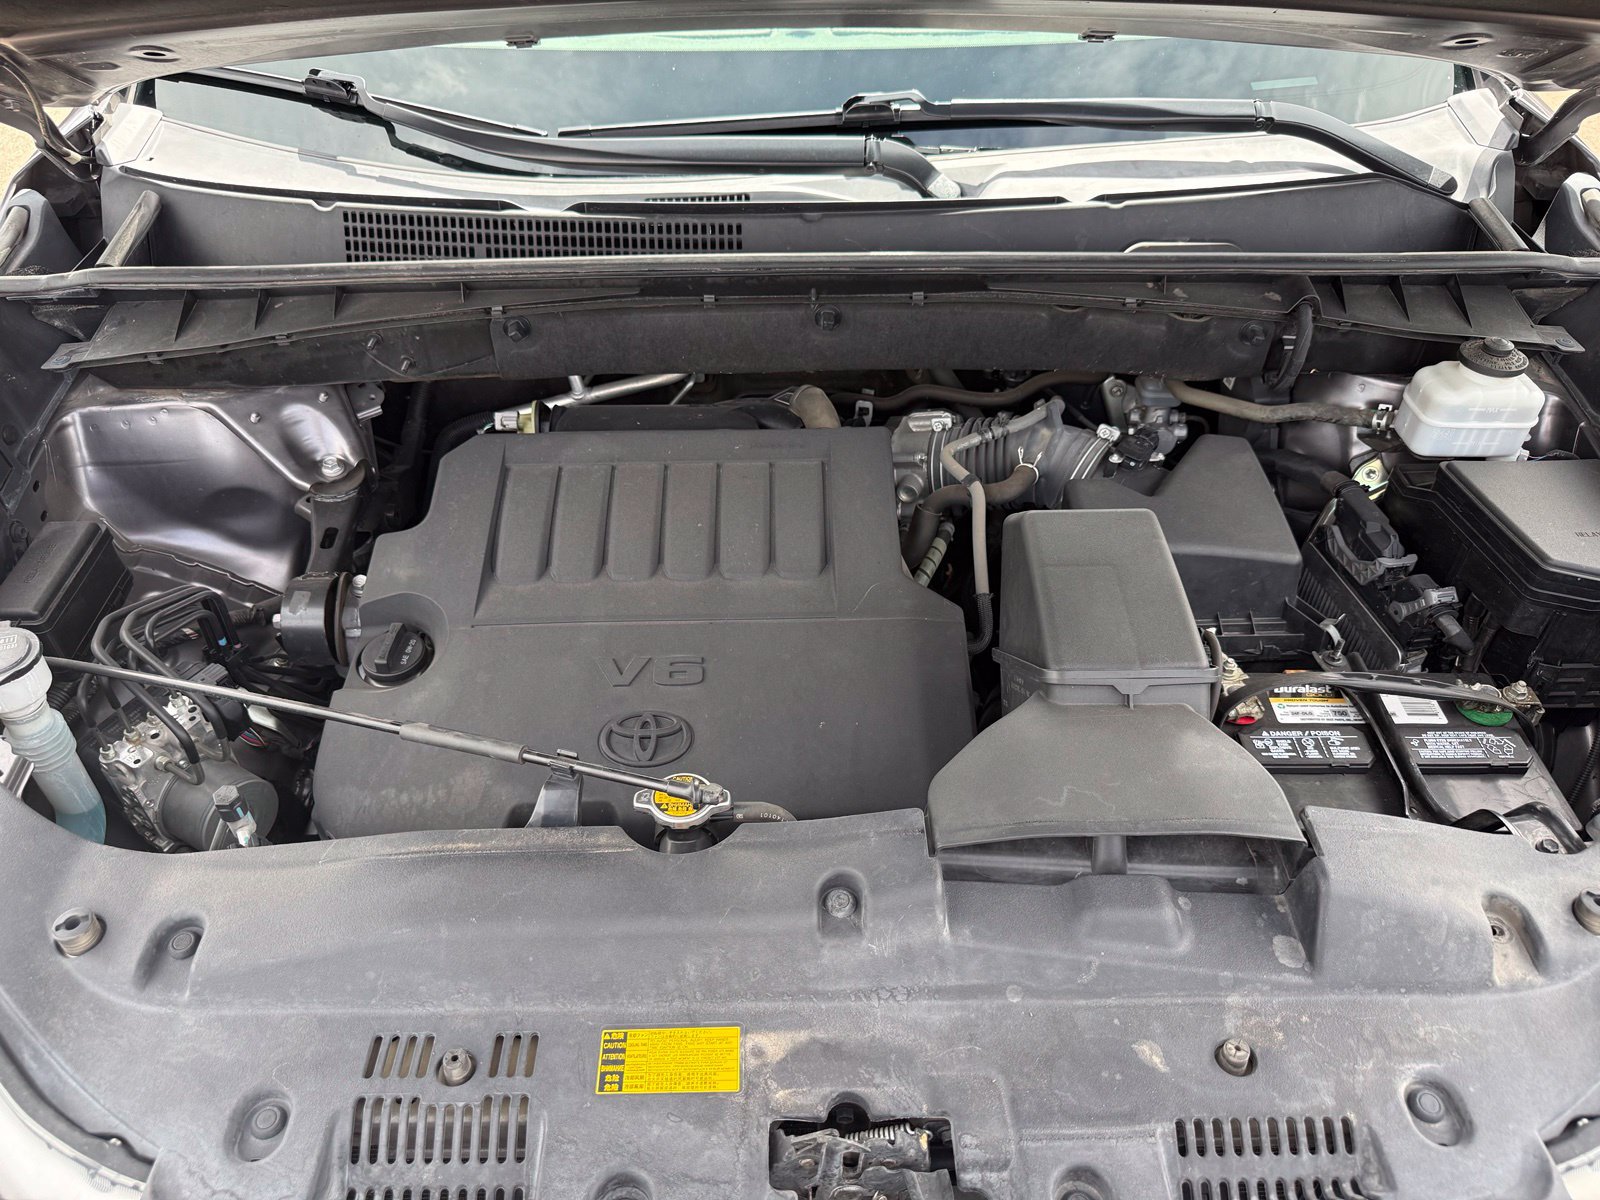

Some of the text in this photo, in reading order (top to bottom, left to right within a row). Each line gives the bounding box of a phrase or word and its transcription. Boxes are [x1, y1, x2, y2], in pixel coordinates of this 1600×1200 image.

[400, 655, 409, 665] SAE
[594, 655, 706, 687] V6
[1273, 684, 1332, 693] duralast
[603, 1041, 627, 1049] CAUTION
